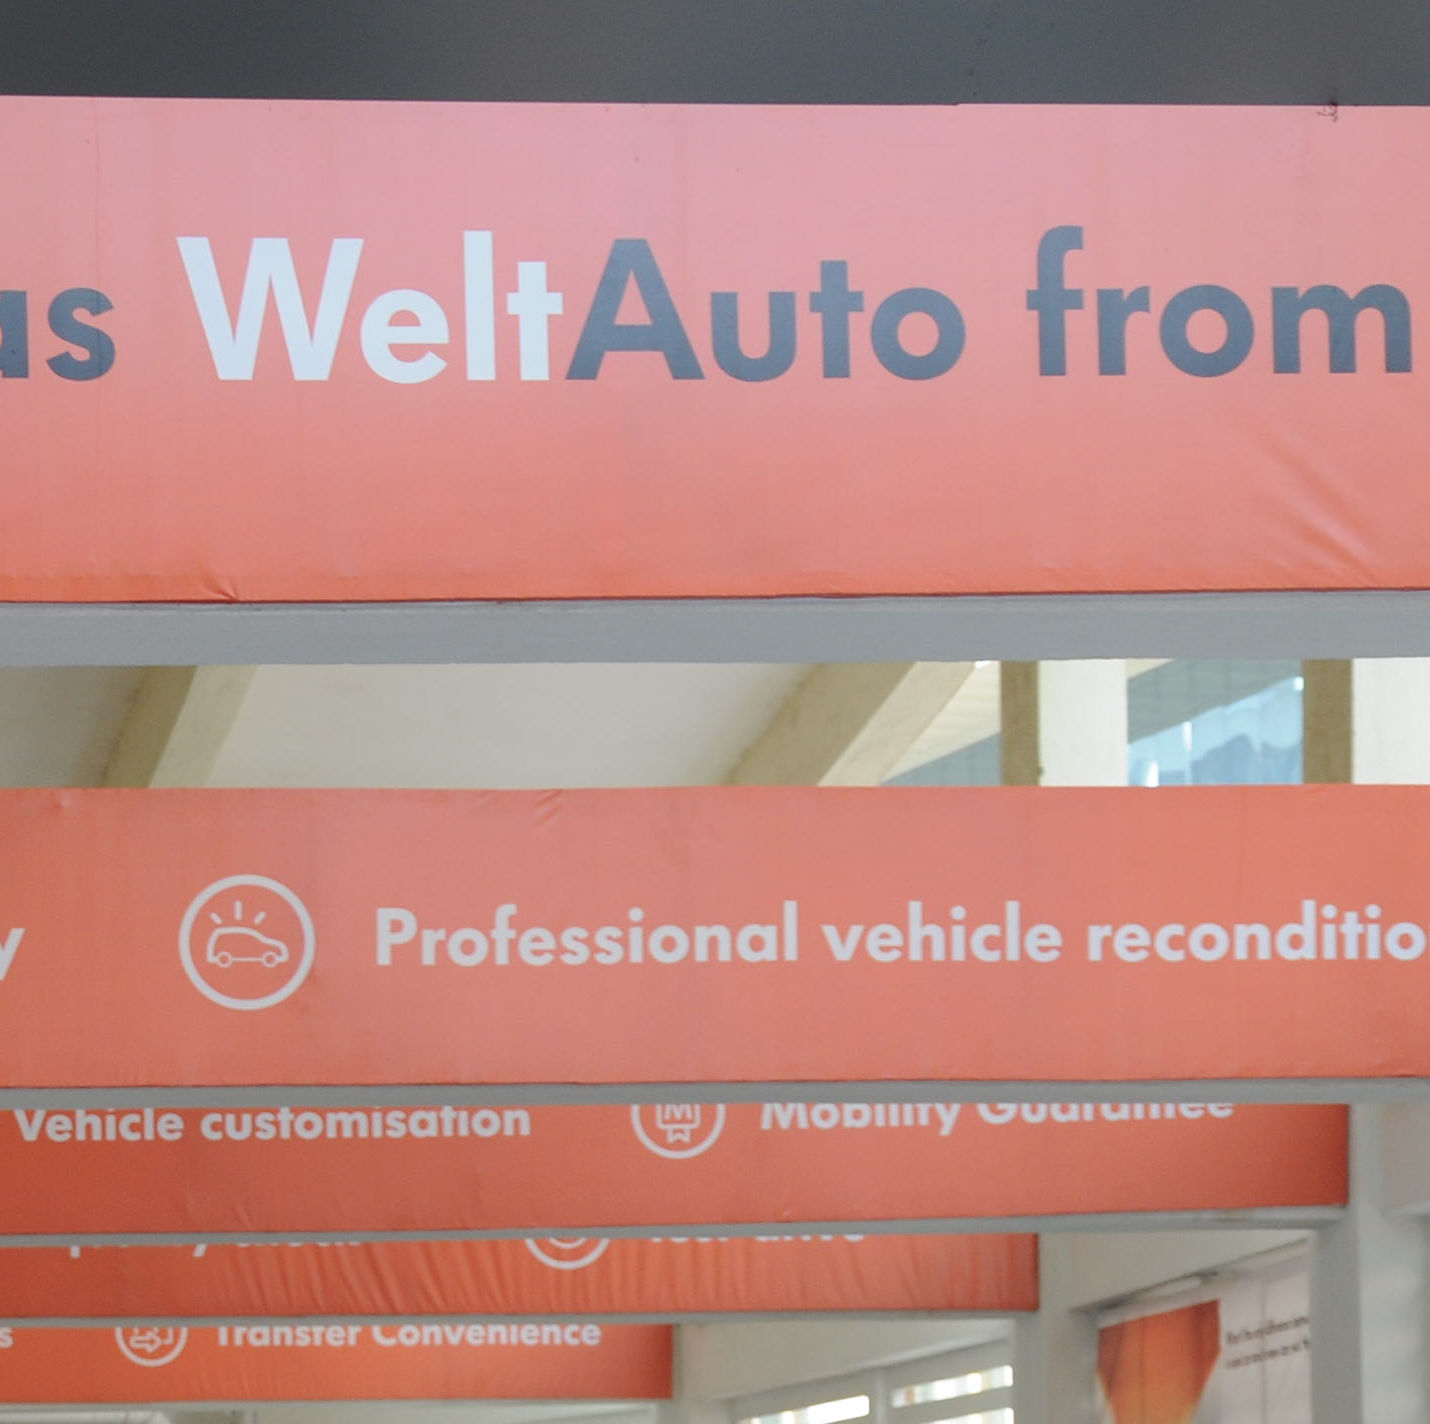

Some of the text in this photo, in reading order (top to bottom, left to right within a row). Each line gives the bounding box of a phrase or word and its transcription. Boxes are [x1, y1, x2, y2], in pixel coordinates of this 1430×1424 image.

[176, 229, 965, 384] WeltAuto
[1028, 227, 1412, 377] from
[374, 899, 799, 968] Professional
[820, 899, 1064, 964] vehicle
[13, 1106, 531, 1143] Vehicle customisation
